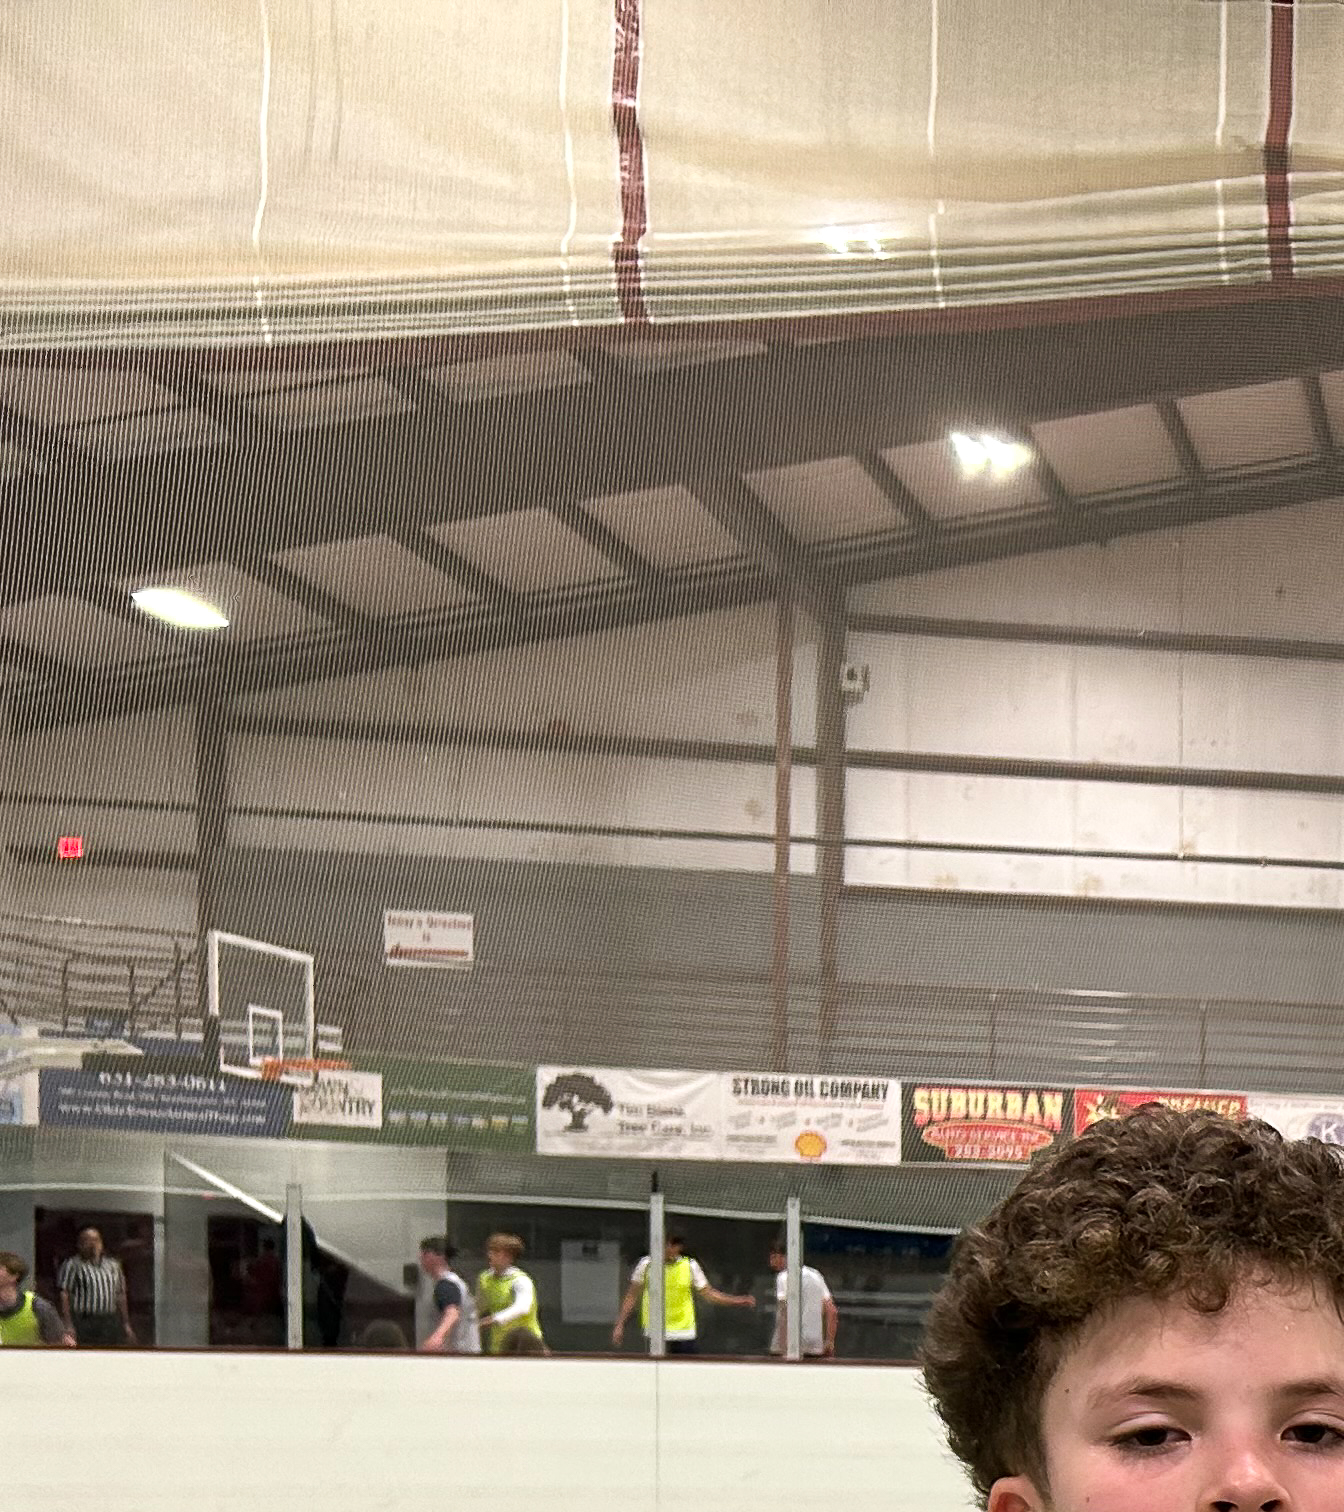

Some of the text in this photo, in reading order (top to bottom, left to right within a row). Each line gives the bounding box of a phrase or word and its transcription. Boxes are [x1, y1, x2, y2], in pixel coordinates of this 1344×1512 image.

[732, 1077, 890, 1102] STRONG OIL COMPANY
[913, 1087, 1064, 1133] SUBURBAN
